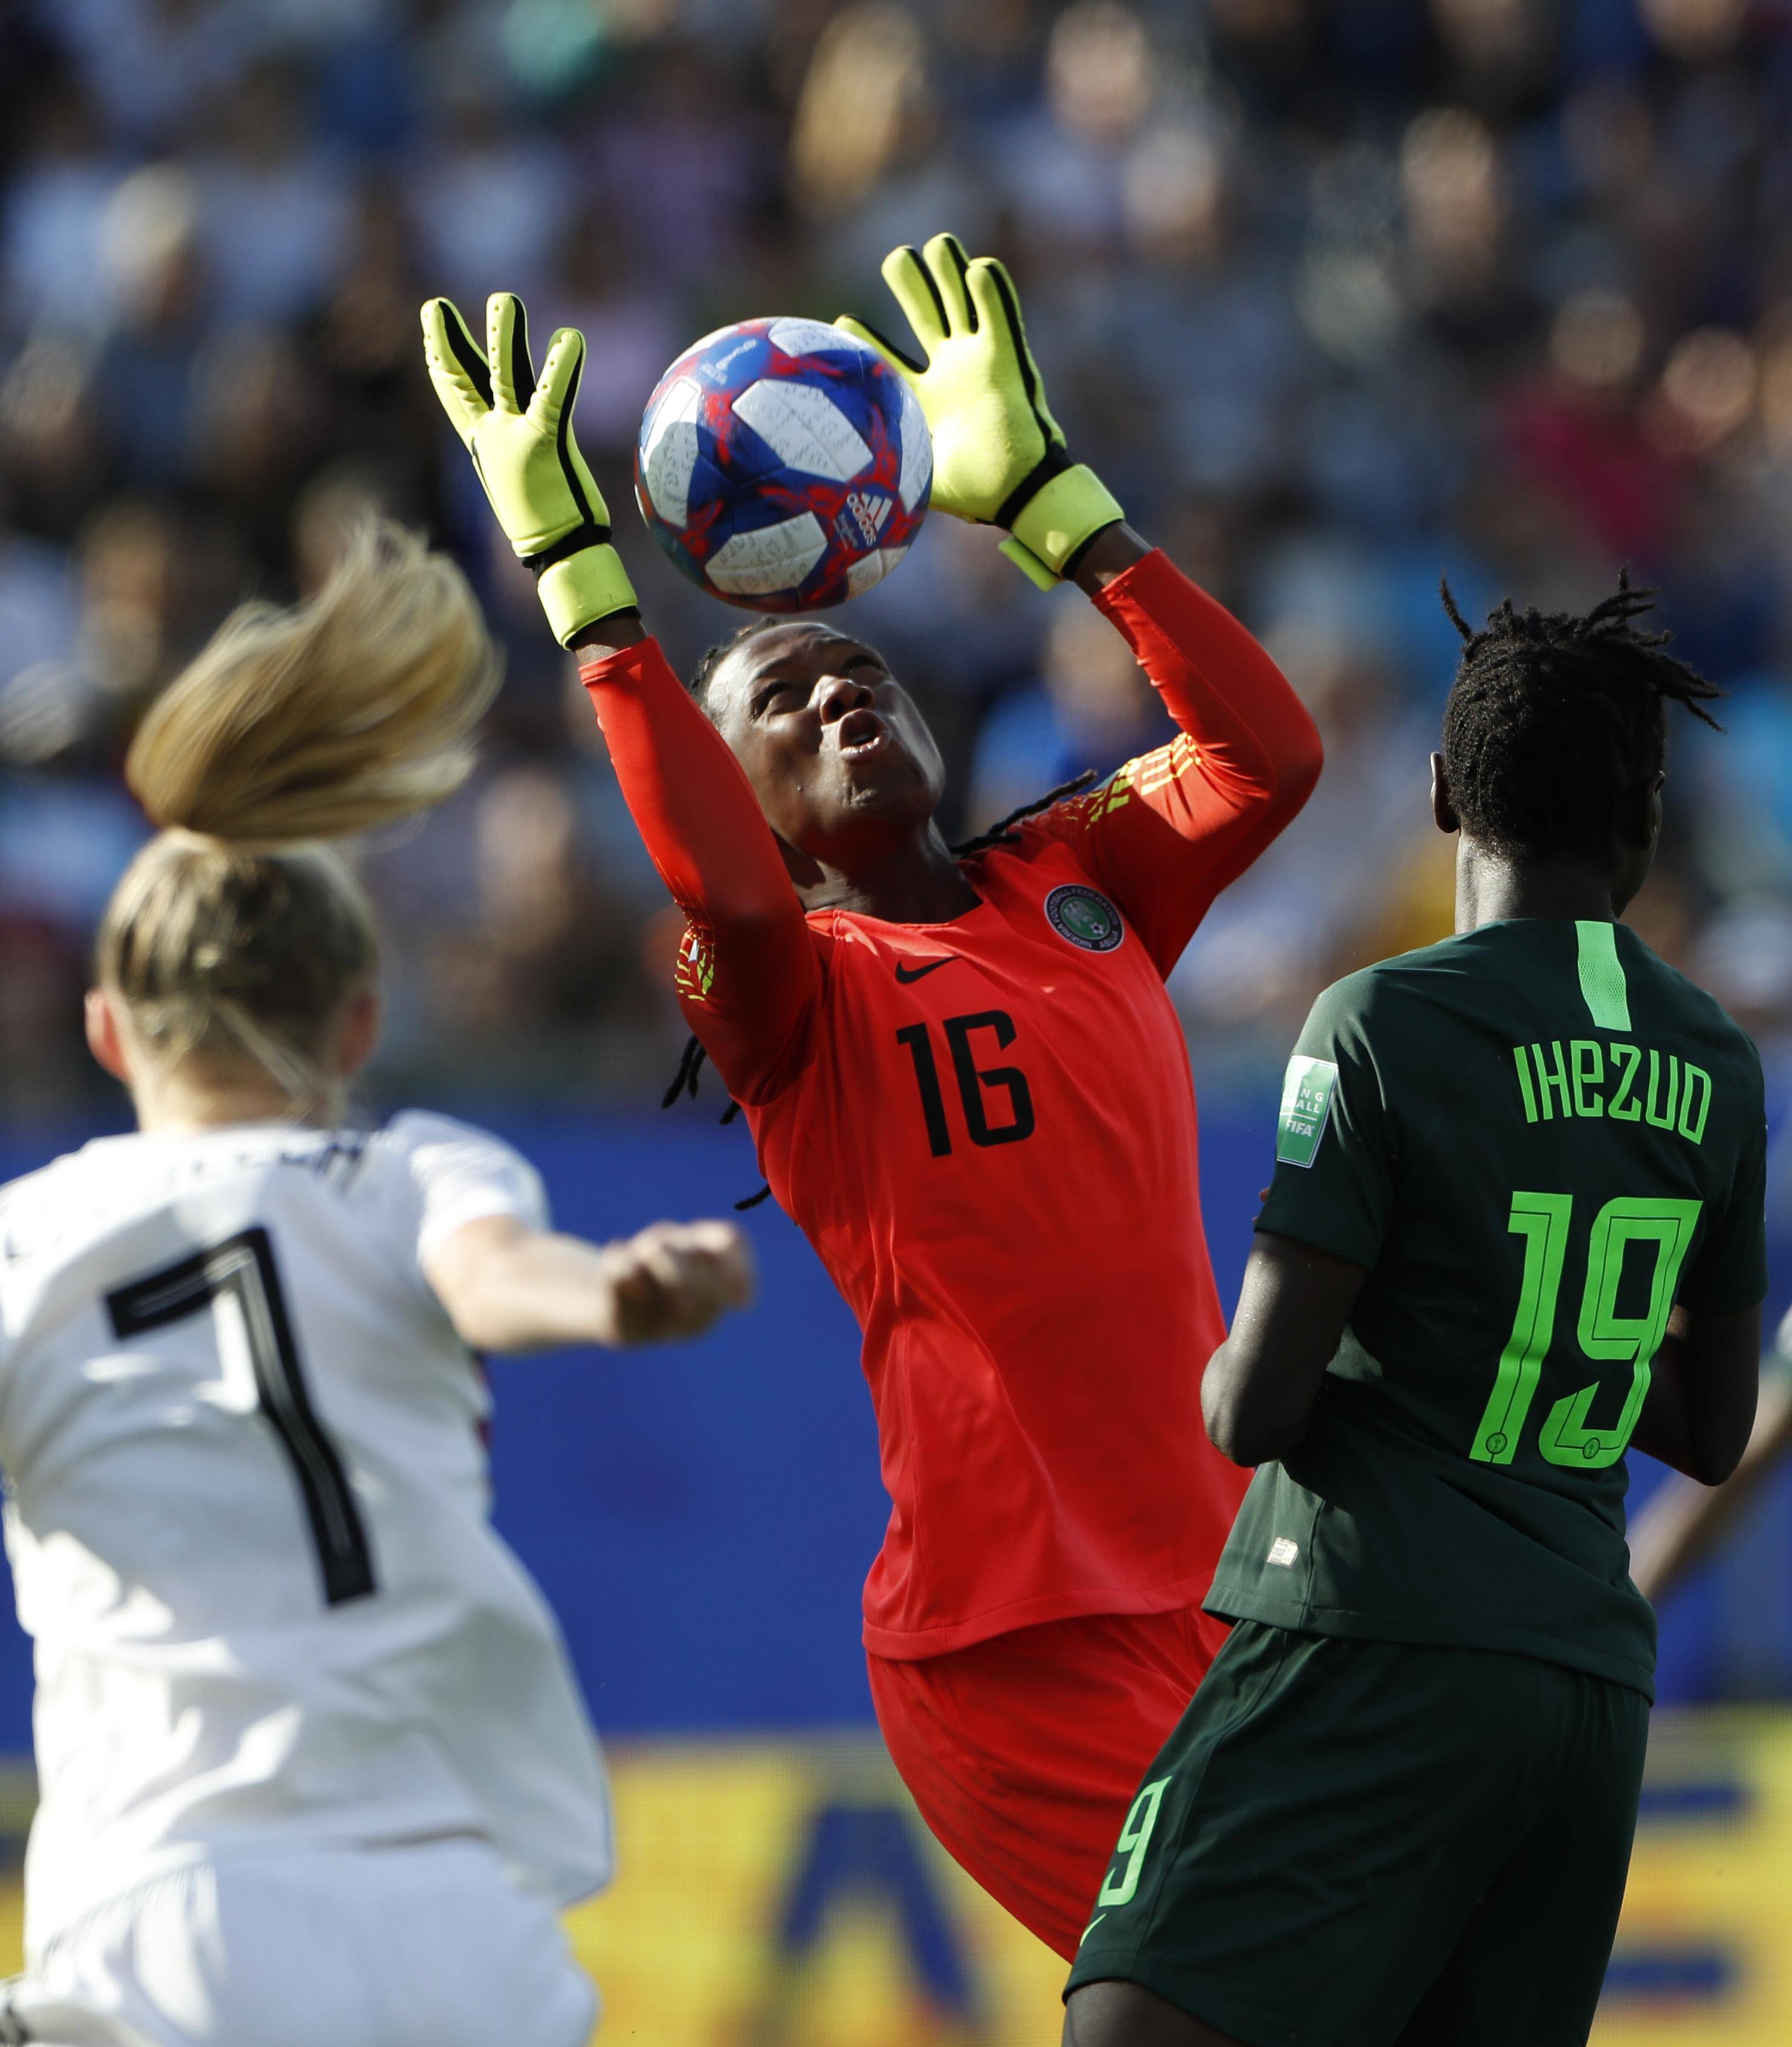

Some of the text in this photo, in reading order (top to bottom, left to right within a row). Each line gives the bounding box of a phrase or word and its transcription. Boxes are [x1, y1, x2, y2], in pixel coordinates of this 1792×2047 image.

[847, 492, 876, 547] adidas
[896, 1010, 1035, 1158] 16
[1285, 1119, 1314, 1138] FIFA
[1469, 1191, 1704, 1469] 19
[104, 1226, 378, 1610] 7
[1098, 1775, 1173, 1907] 9
